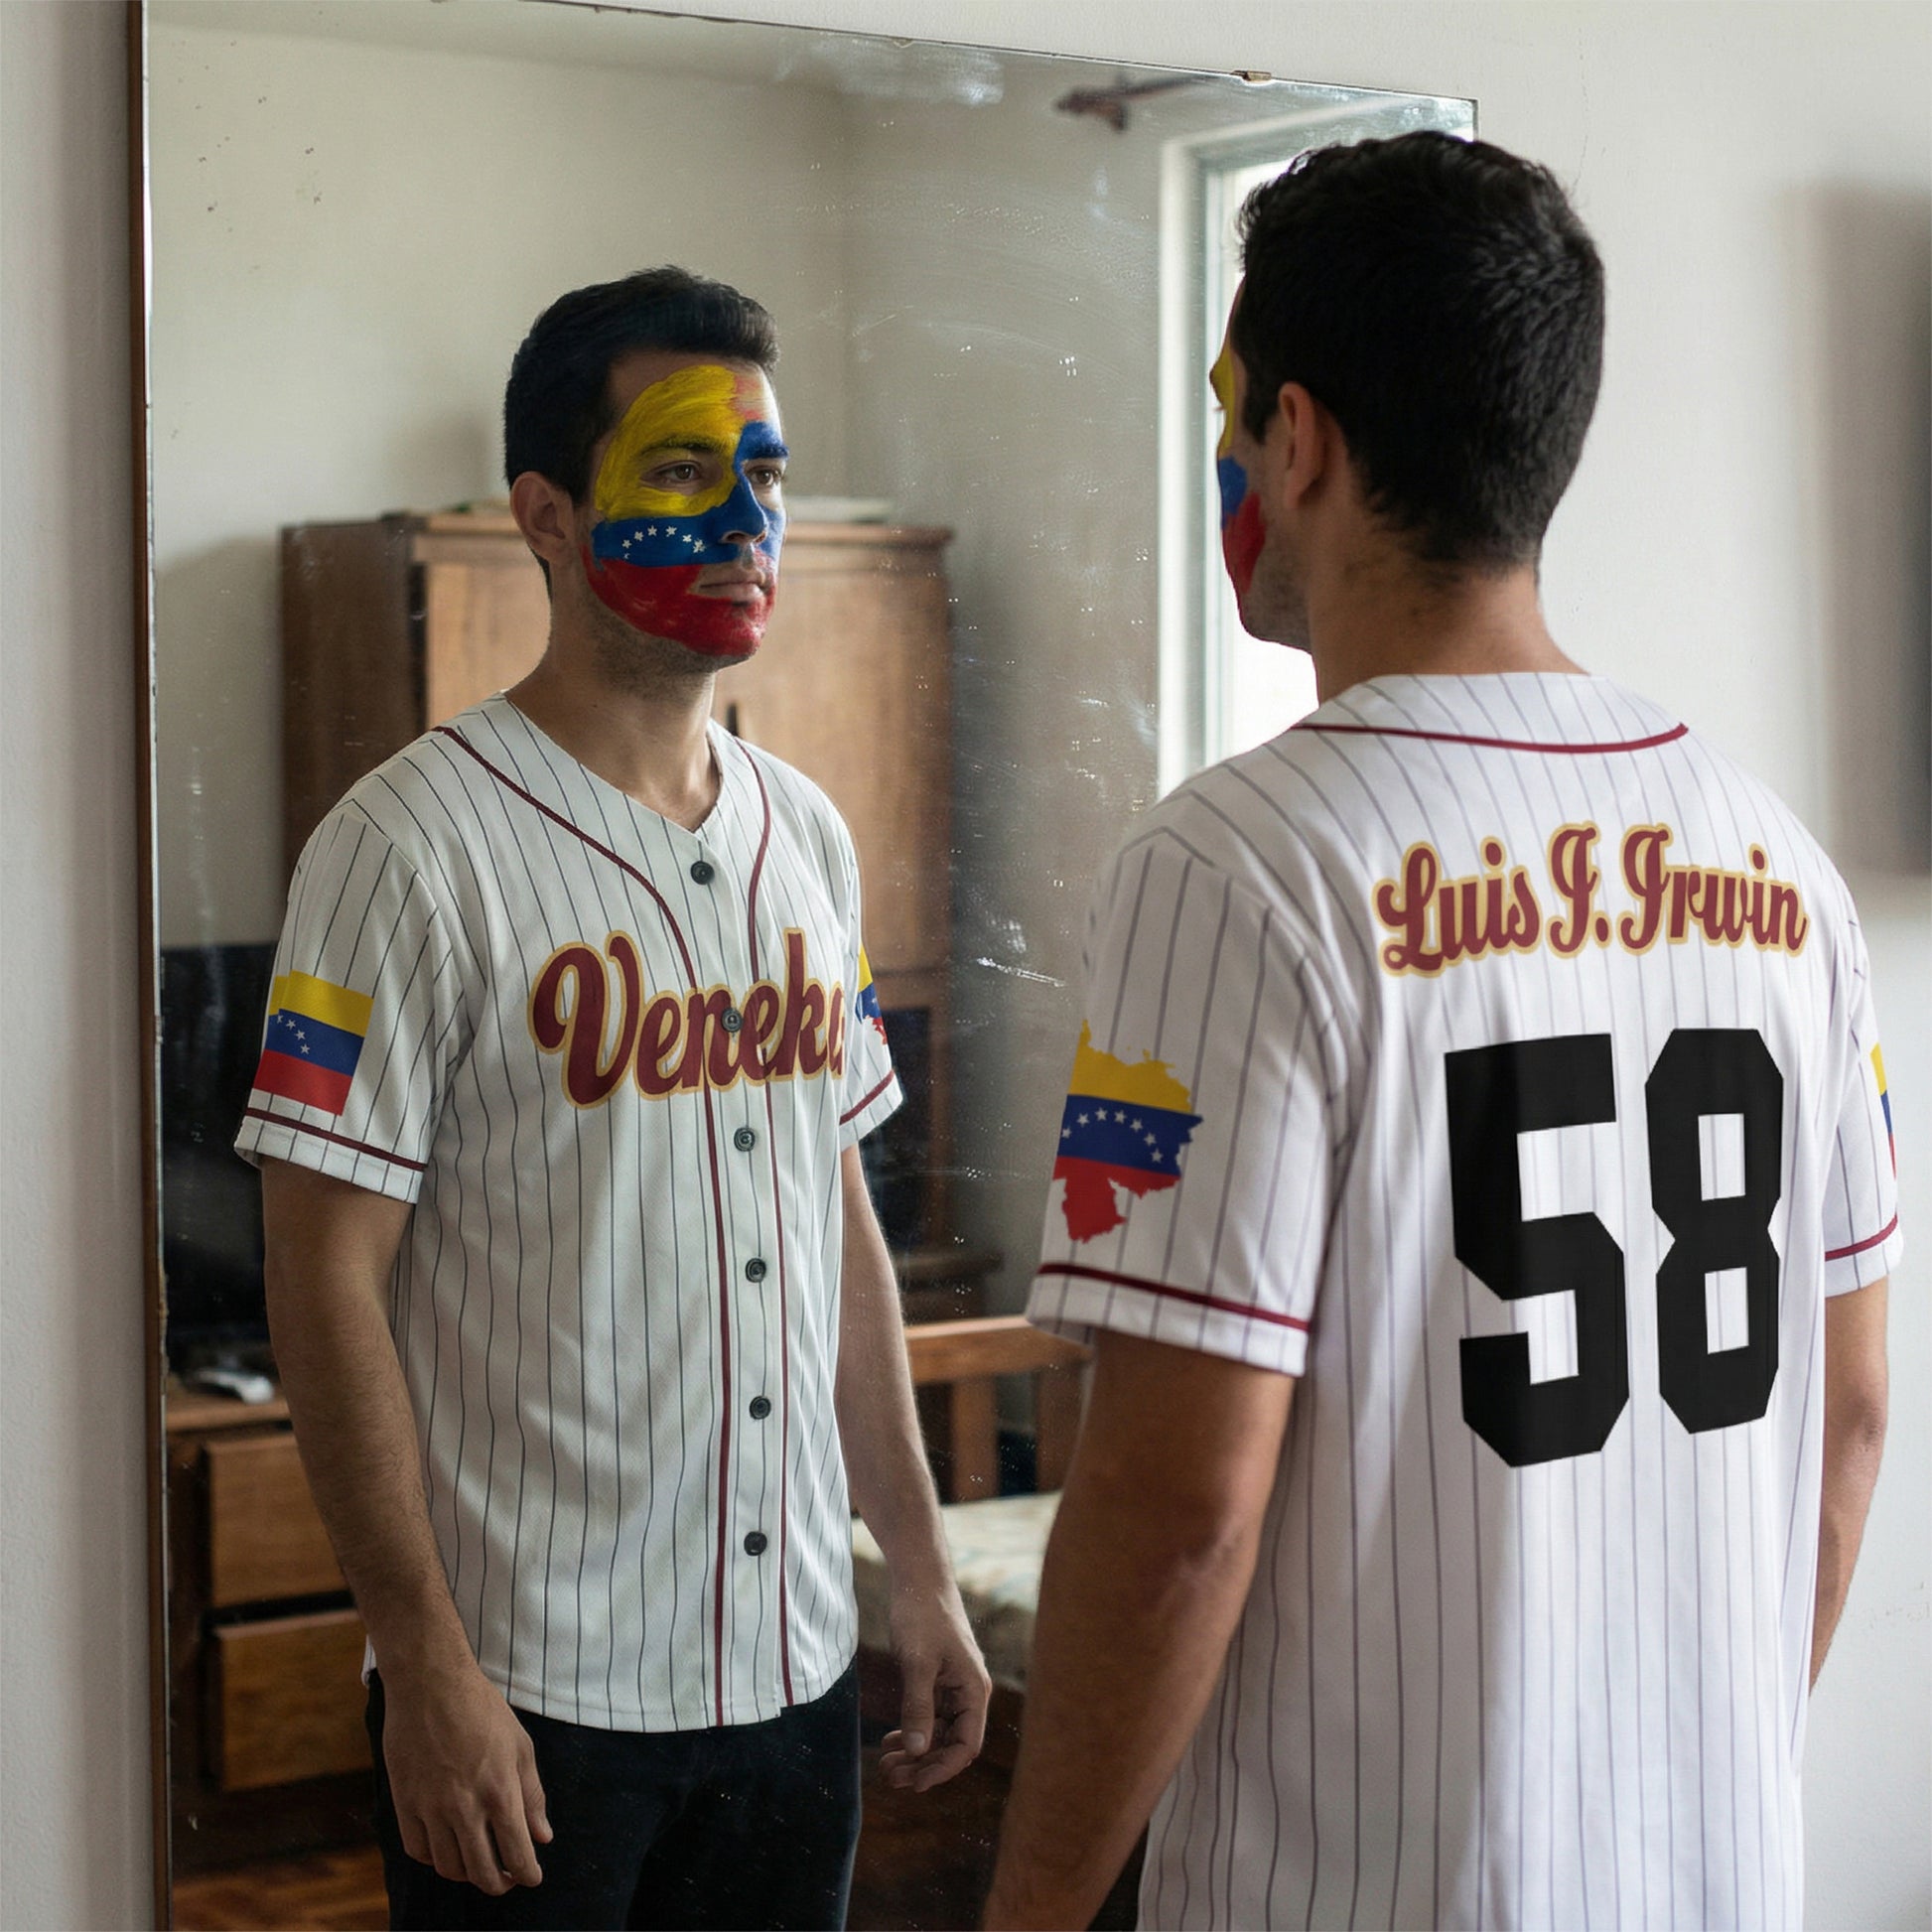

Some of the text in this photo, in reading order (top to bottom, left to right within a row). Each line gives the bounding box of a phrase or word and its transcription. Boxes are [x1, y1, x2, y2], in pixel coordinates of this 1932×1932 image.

[1372, 836, 1543, 977] Luis
[1617, 822, 1809, 956] Irwin
[1444, 1028, 1784, 1468] 58
